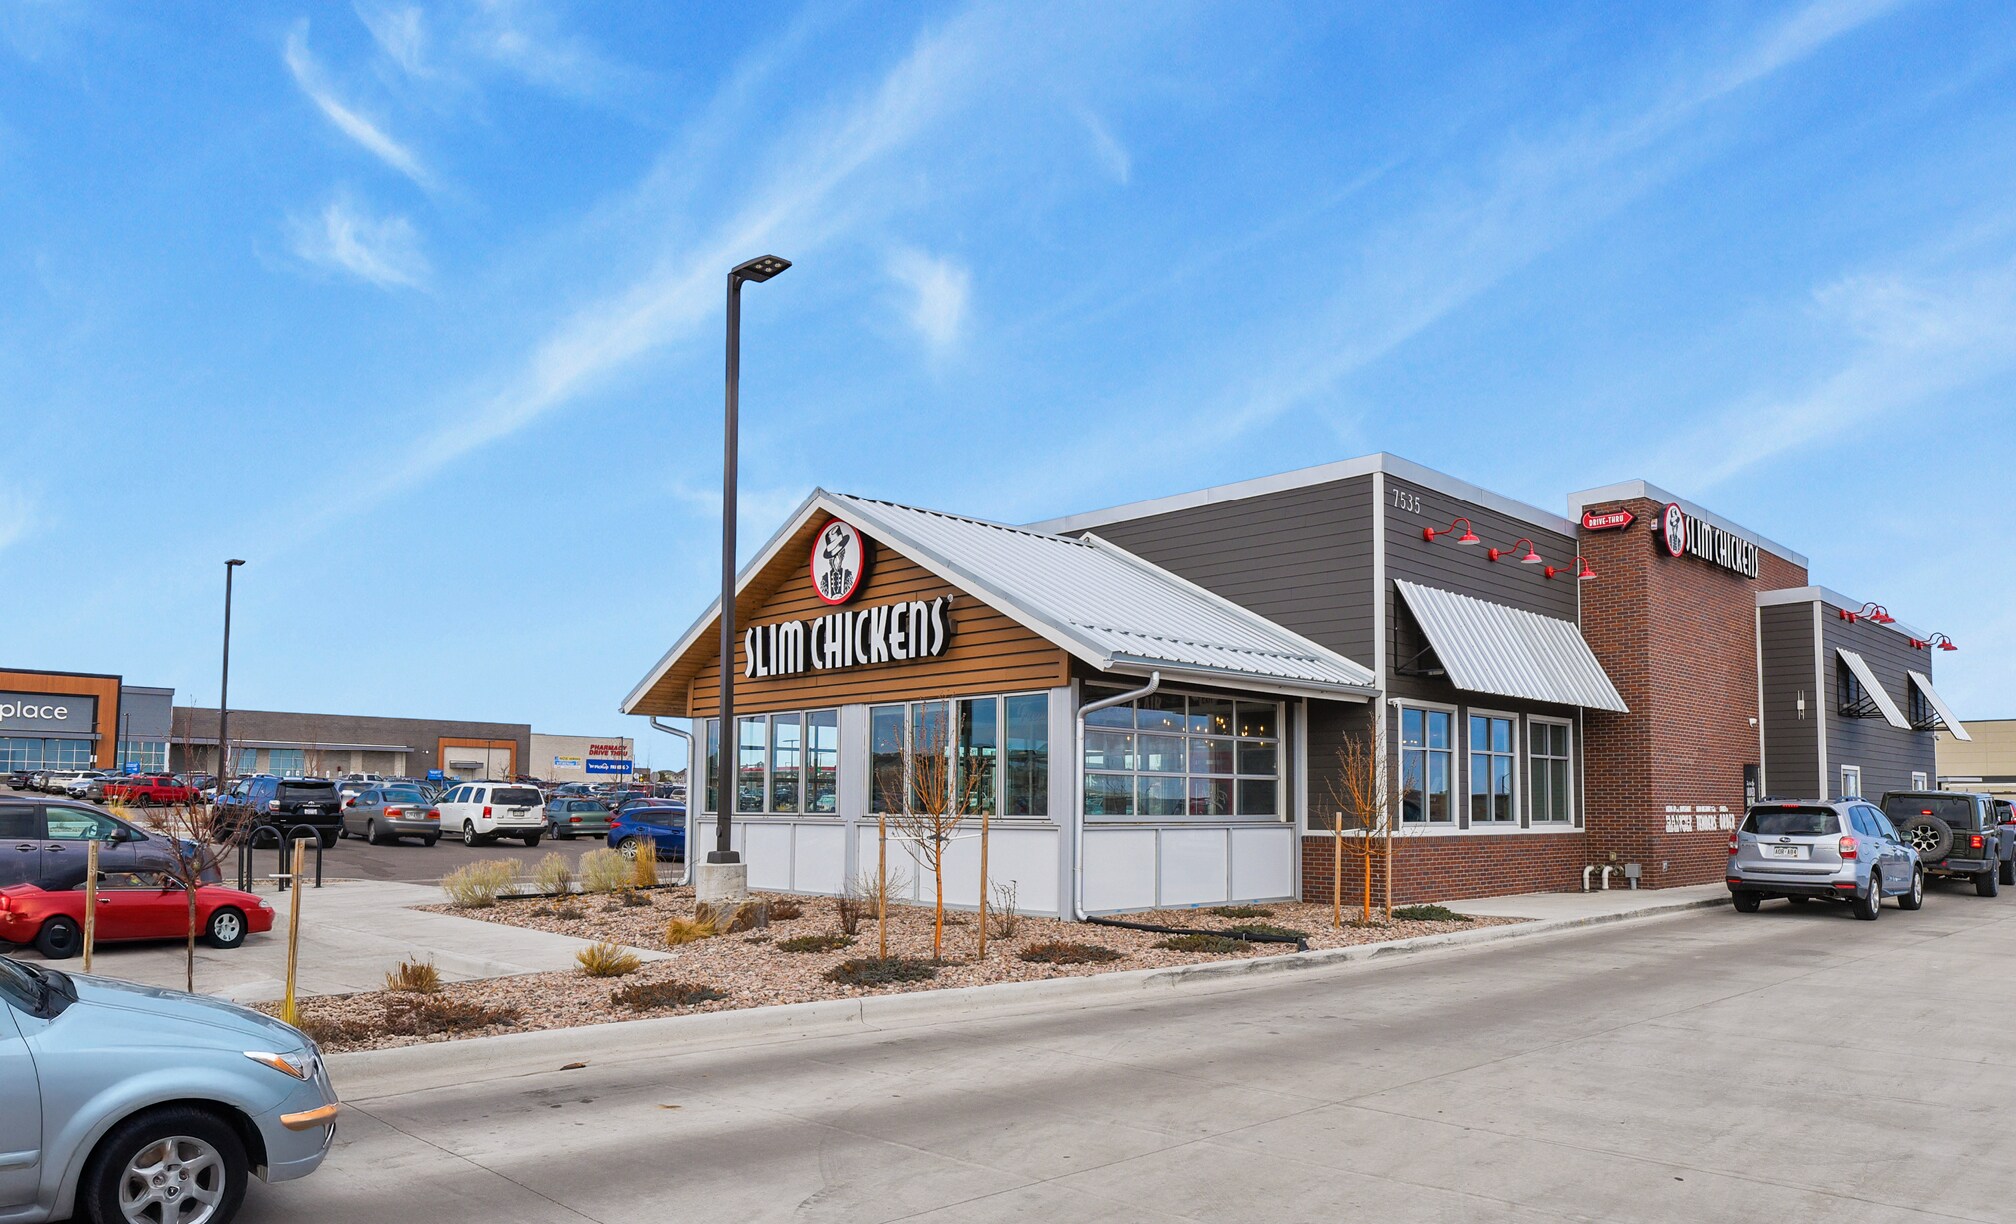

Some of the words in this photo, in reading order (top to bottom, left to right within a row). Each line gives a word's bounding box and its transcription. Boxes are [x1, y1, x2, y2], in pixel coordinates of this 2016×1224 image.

[1392, 488, 1420, 514] 7535
[1588, 514, 1624, 527] DRIVE-THRU
[1685, 515, 1713, 562] SLIM
[1714, 527, 1760, 579] CHICKENS
[744, 619, 806, 679] SLIM
[811, 596, 946, 670] CHICKENS
[0, 700, 68, 720] place
